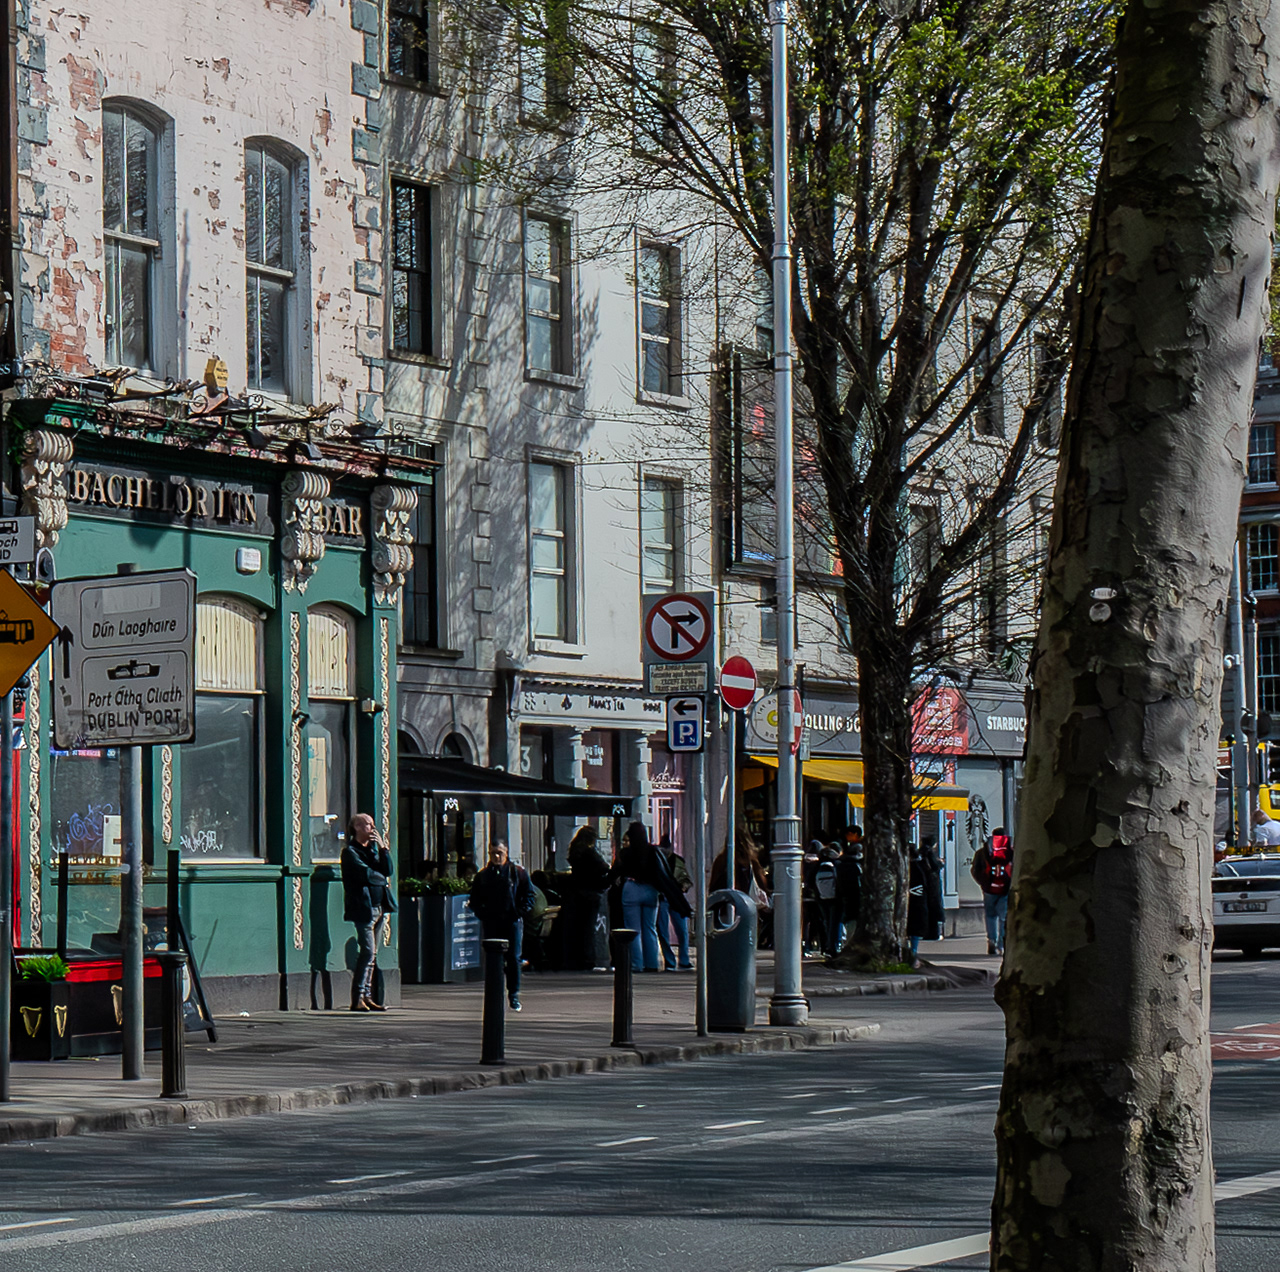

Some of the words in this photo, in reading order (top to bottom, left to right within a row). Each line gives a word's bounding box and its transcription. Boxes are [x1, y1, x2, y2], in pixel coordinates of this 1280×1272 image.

[212, 488, 258, 525] INN
[320, 500, 362, 536] BAR
[92, 619, 114, 638] Dún
[119, 617, 177, 638] Laoghaire
[88, 692, 111, 708] Port
[146, 685, 182, 704] Cliath
[88, 711, 139, 731] DUBLIN
[145, 708, 182, 727] PORT
[804, 713, 843, 731] OLLING
[987, 715, 1026, 732] STARBUC
